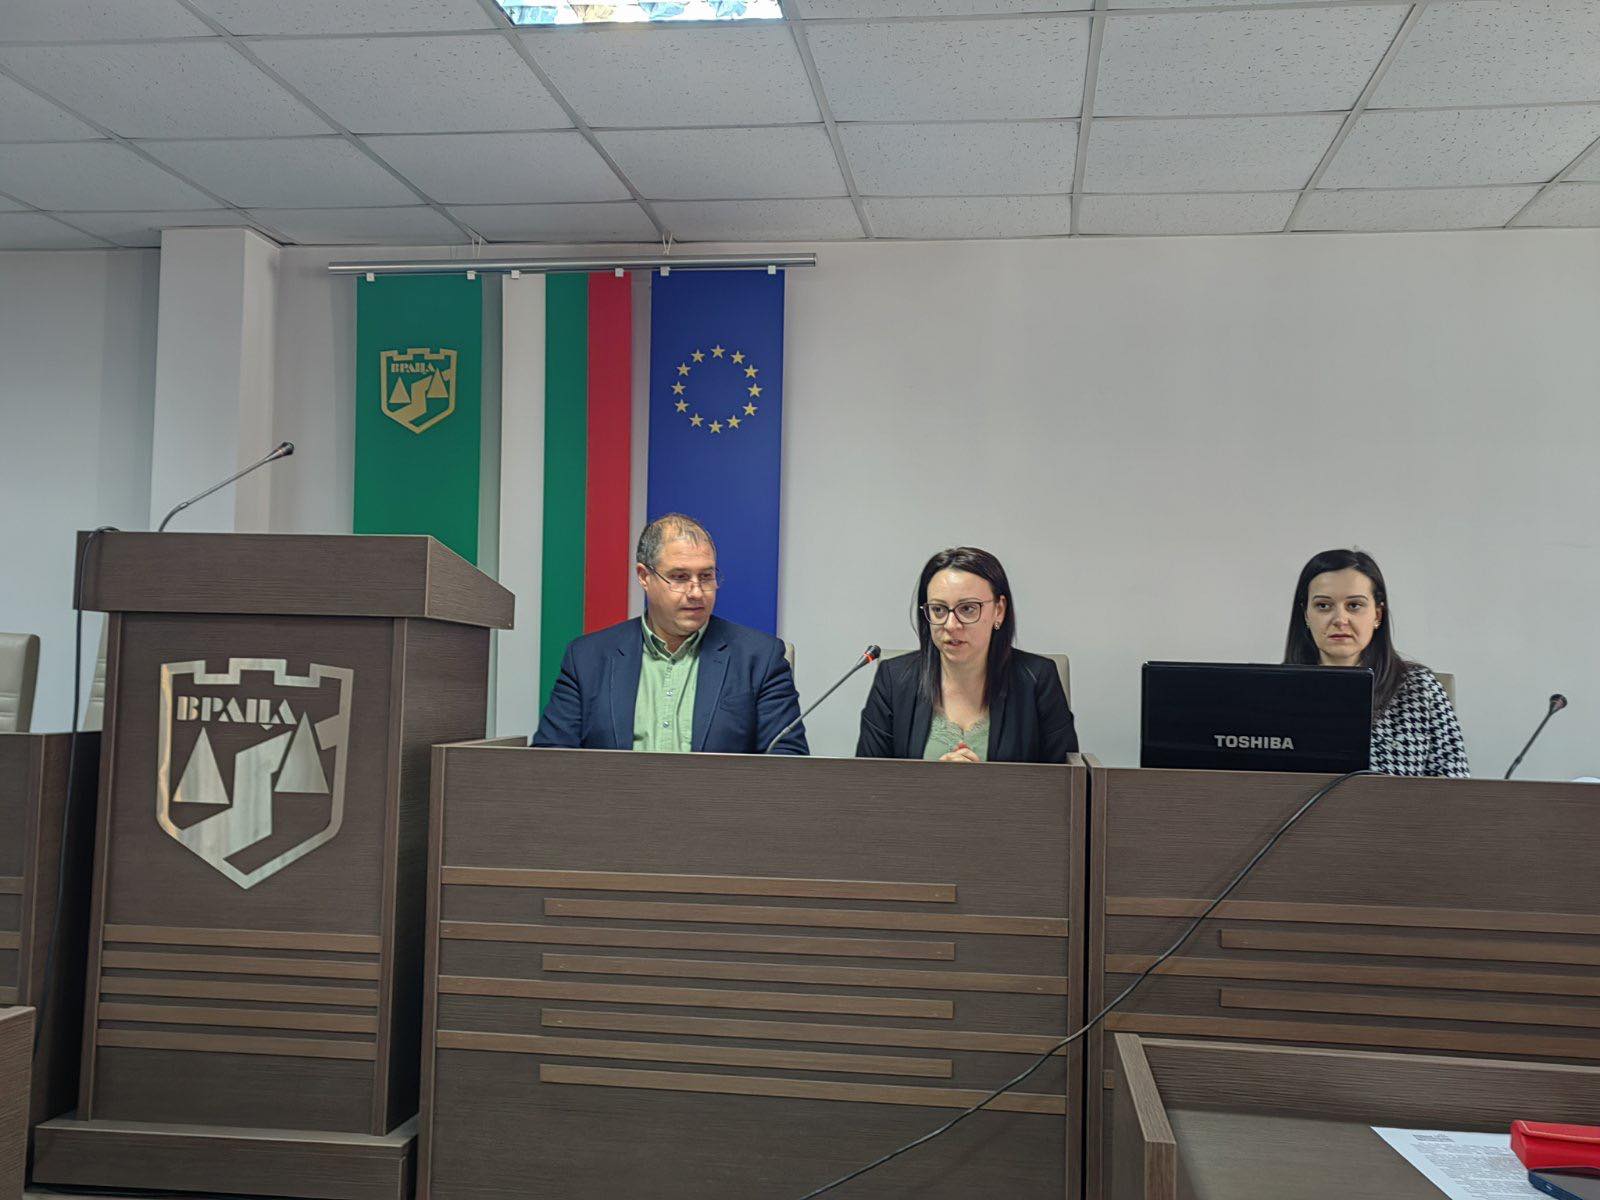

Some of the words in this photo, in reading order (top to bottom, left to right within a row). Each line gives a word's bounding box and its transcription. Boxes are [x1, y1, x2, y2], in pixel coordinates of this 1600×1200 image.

[391, 362, 435, 374] ВРАЦА
[176, 696, 298, 730] ВРАЦА
[1214, 734, 1294, 750] TOSHIBA
